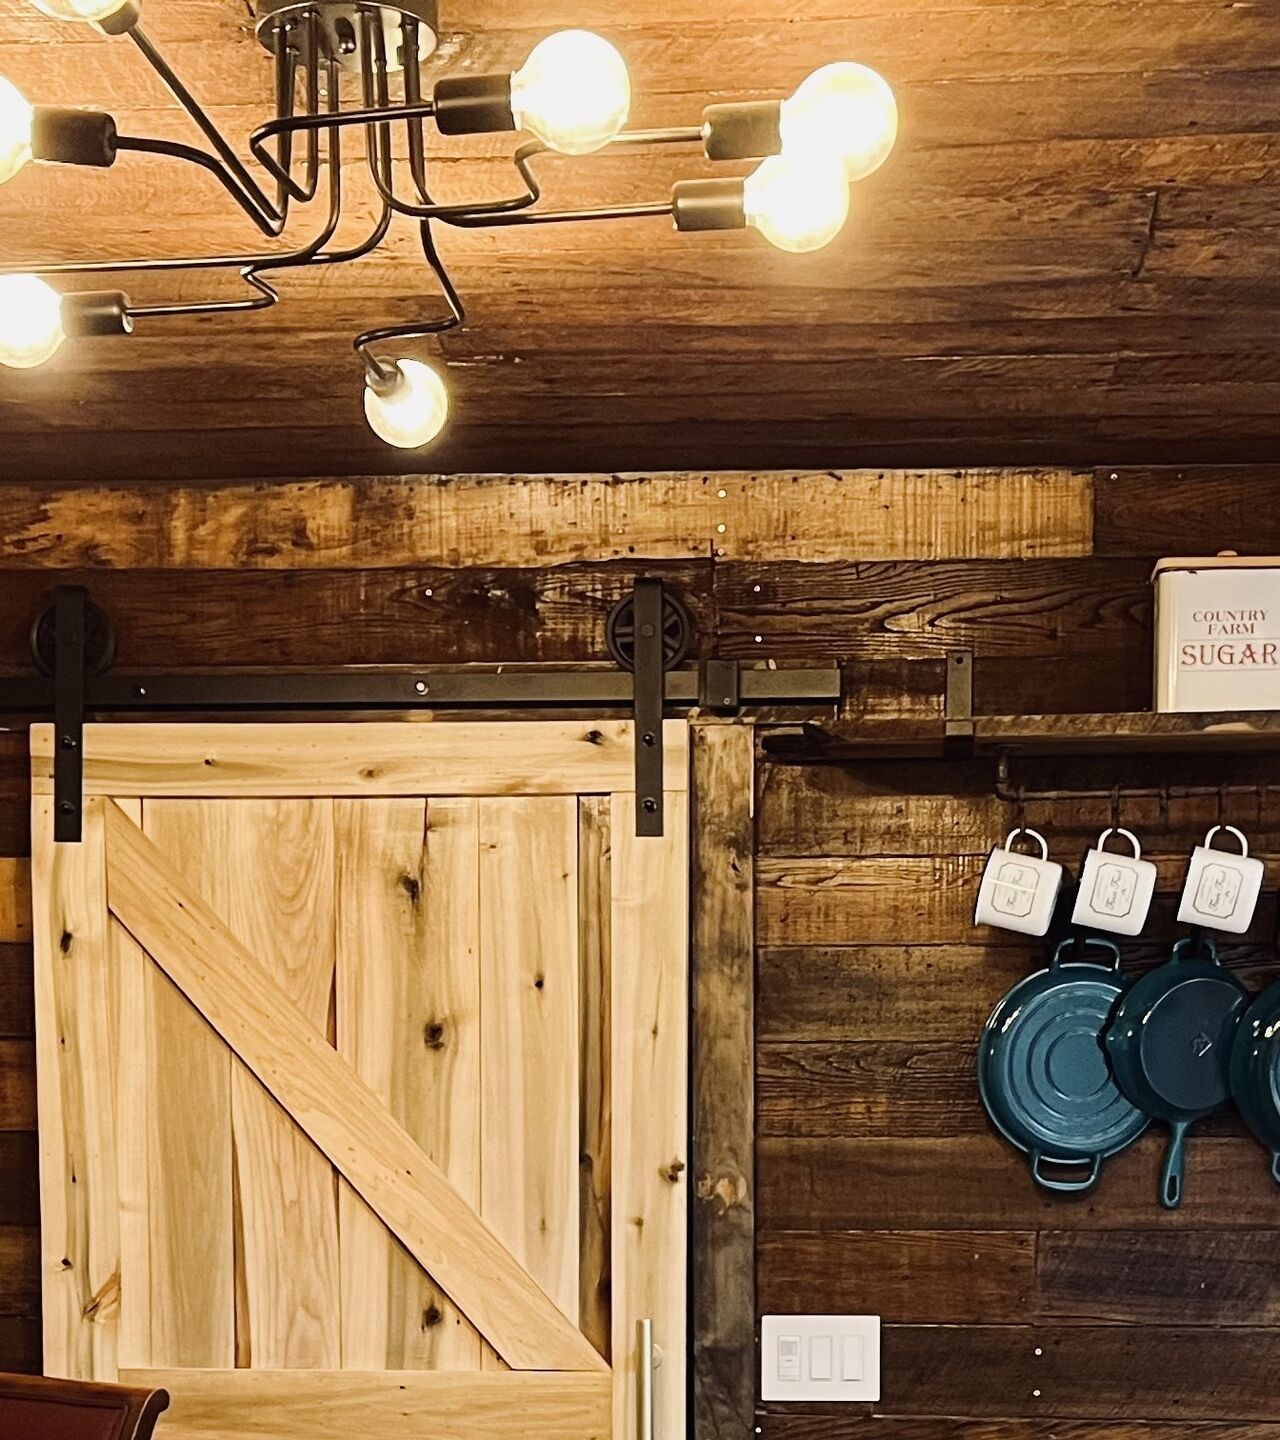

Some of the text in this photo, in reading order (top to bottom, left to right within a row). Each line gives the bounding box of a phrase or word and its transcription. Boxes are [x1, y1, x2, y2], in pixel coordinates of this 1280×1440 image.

[1192, 608, 1270, 624] COUNTRY
[1207, 623, 1256, 636] FARM
[1180, 642, 1280, 667] SUGAR
